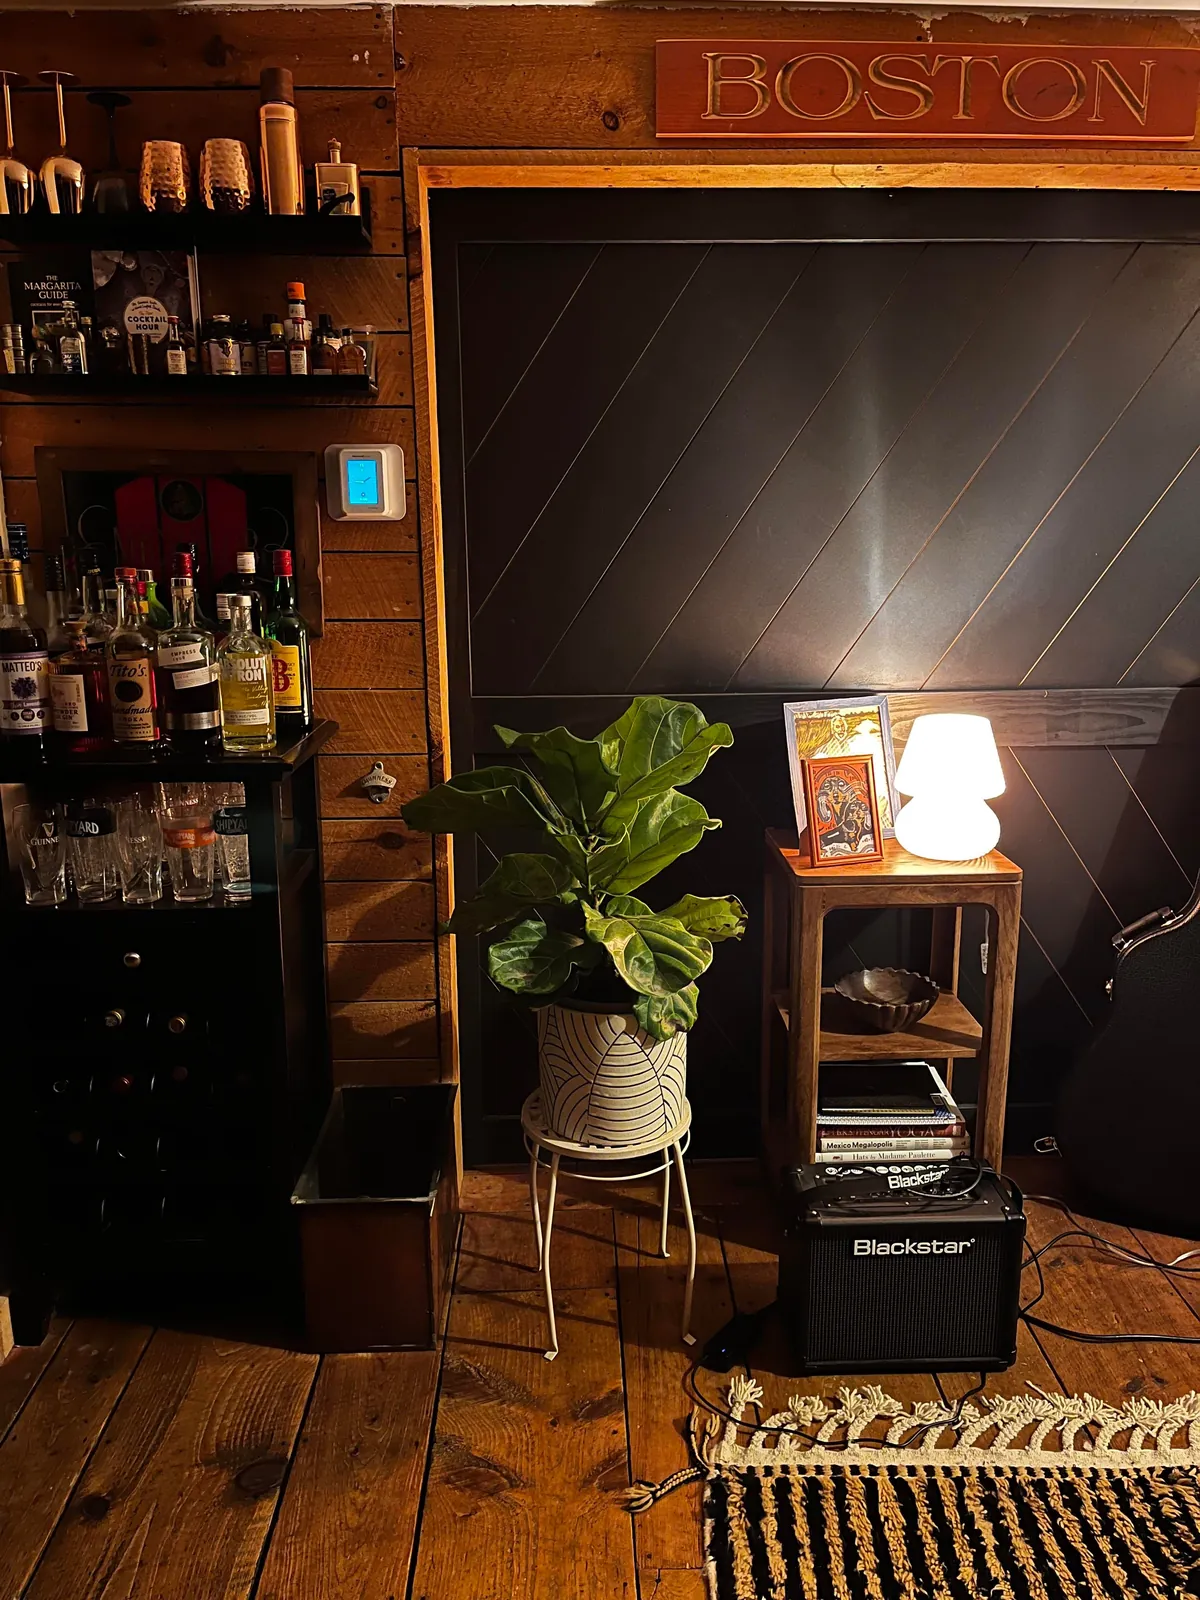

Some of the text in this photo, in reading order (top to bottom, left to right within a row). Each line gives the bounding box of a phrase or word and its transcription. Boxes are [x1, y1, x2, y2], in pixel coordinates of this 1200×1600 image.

[701, 51, 1158, 126] BOSTON
[23, 281, 82, 291] MARGARITA
[38, 291, 69, 300] GUIDE
[171, 649, 197, 657] EMPRESS
[2, 661, 42, 673] MATTEO'S
[826, 1142, 852, 1150] Mexico
[852, 1140, 893, 1150] Megalopolis
[852, 1153, 869, 1161] Hats
[878, 1152, 907, 1160] Madame
[908, 1151, 936, 1160] Paulette
[887, 1169, 947, 1190] Blackstar
[853, 1238, 972, 1256] Blackstar
